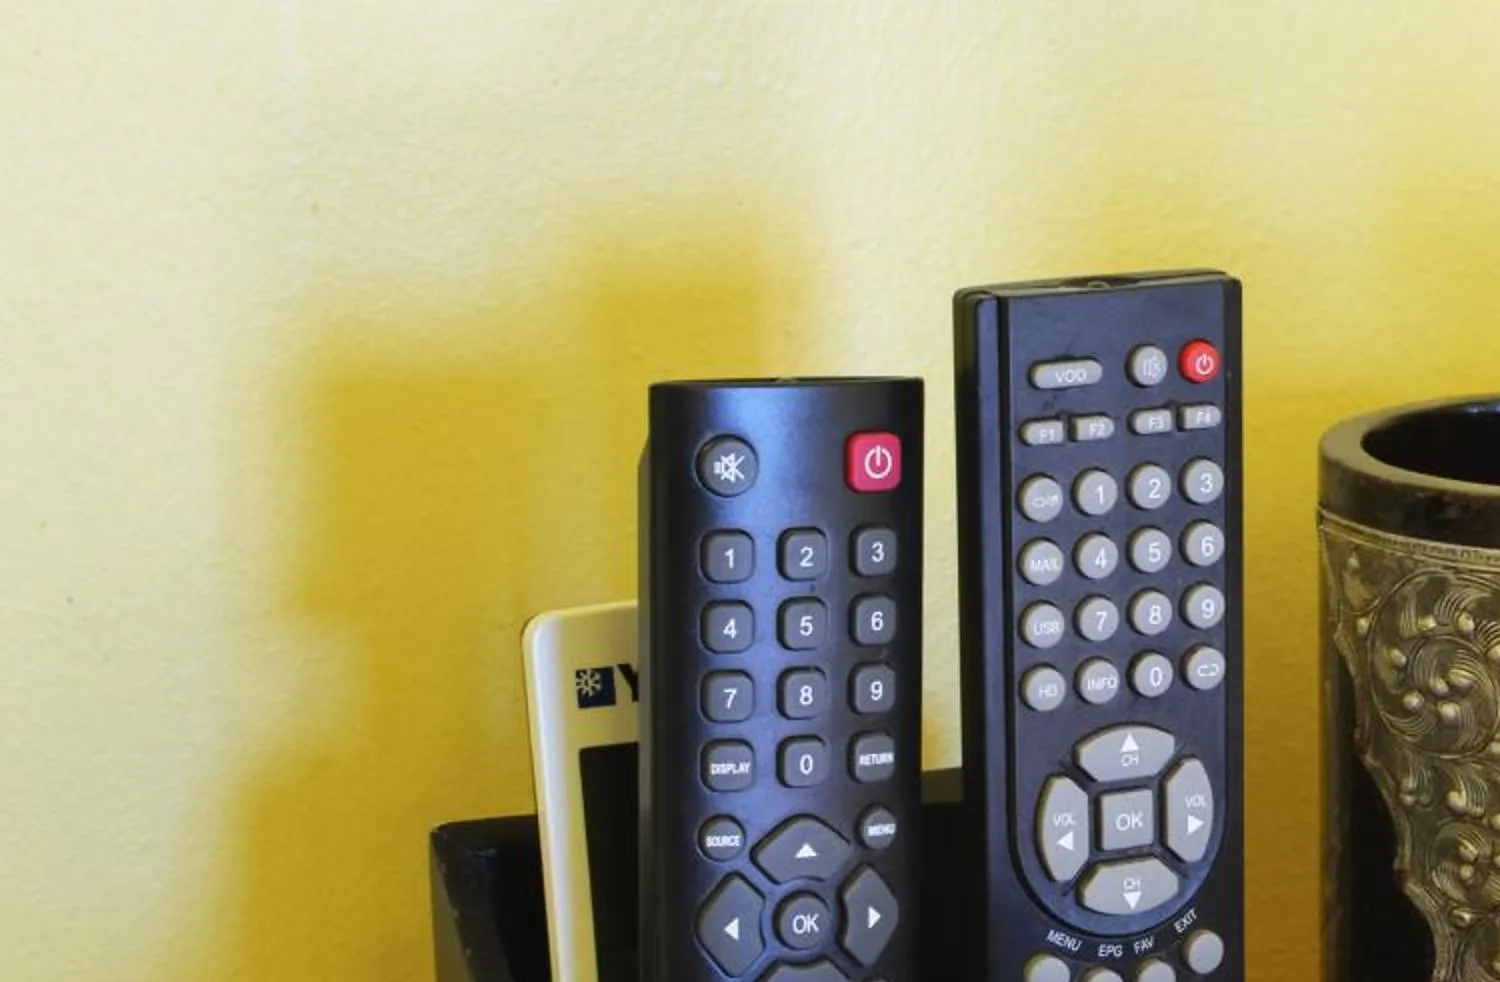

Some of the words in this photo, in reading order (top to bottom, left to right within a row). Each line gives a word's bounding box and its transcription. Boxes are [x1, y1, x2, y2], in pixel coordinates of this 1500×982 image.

[1149, 417, 1164, 431] F3
[1196, 411, 1210, 423] F4
[1040, 428, 1055, 441] F1
[1089, 423, 1105, 437] F2
[1149, 479, 1161, 499] 2
[1200, 473, 1213, 493] 3
[1096, 485, 1104, 505] 1
[800, 546, 814, 567] 2
[871, 541, 885, 562] 3
[1148, 542, 1161, 563] 5
[1201, 536, 1215, 557] 6
[724, 548, 735, 569] 1
[1094, 548, 1106, 569] 4
[1148, 605, 1163, 625] 8
[1201, 598, 1215, 619] 9
[723, 618, 737, 639] 4
[800, 615, 814, 636] 5
[871, 611, 884, 631] 6
[1096, 611, 1108, 631] 7
[1087, 675, 1118, 691] INFO
[1149, 666, 1163, 687] 0
[723, 688, 737, 709] 7
[800, 685, 814, 706] 8
[870, 681, 884, 701] 9
[710, 762, 751, 775] DISPLAY
[800, 754, 813, 775] 0
[859, 752, 894, 766] RETURN
[1121, 754, 1139, 767] CH
[1185, 795, 1207, 808] VOL
[867, 823, 896, 836] MENU
[1053, 812, 1077, 827] VOL
[1116, 812, 1144, 831] OK
[706, 835, 741, 847] SOURCE
[1123, 876, 1141, 890] CH
[792, 913, 819, 934] OK
[1046, 929, 1082, 951] MENU
[1098, 944, 1124, 958] EPG
[1133, 936, 1154, 954] FAV
[1173, 908, 1197, 933] EXIT
